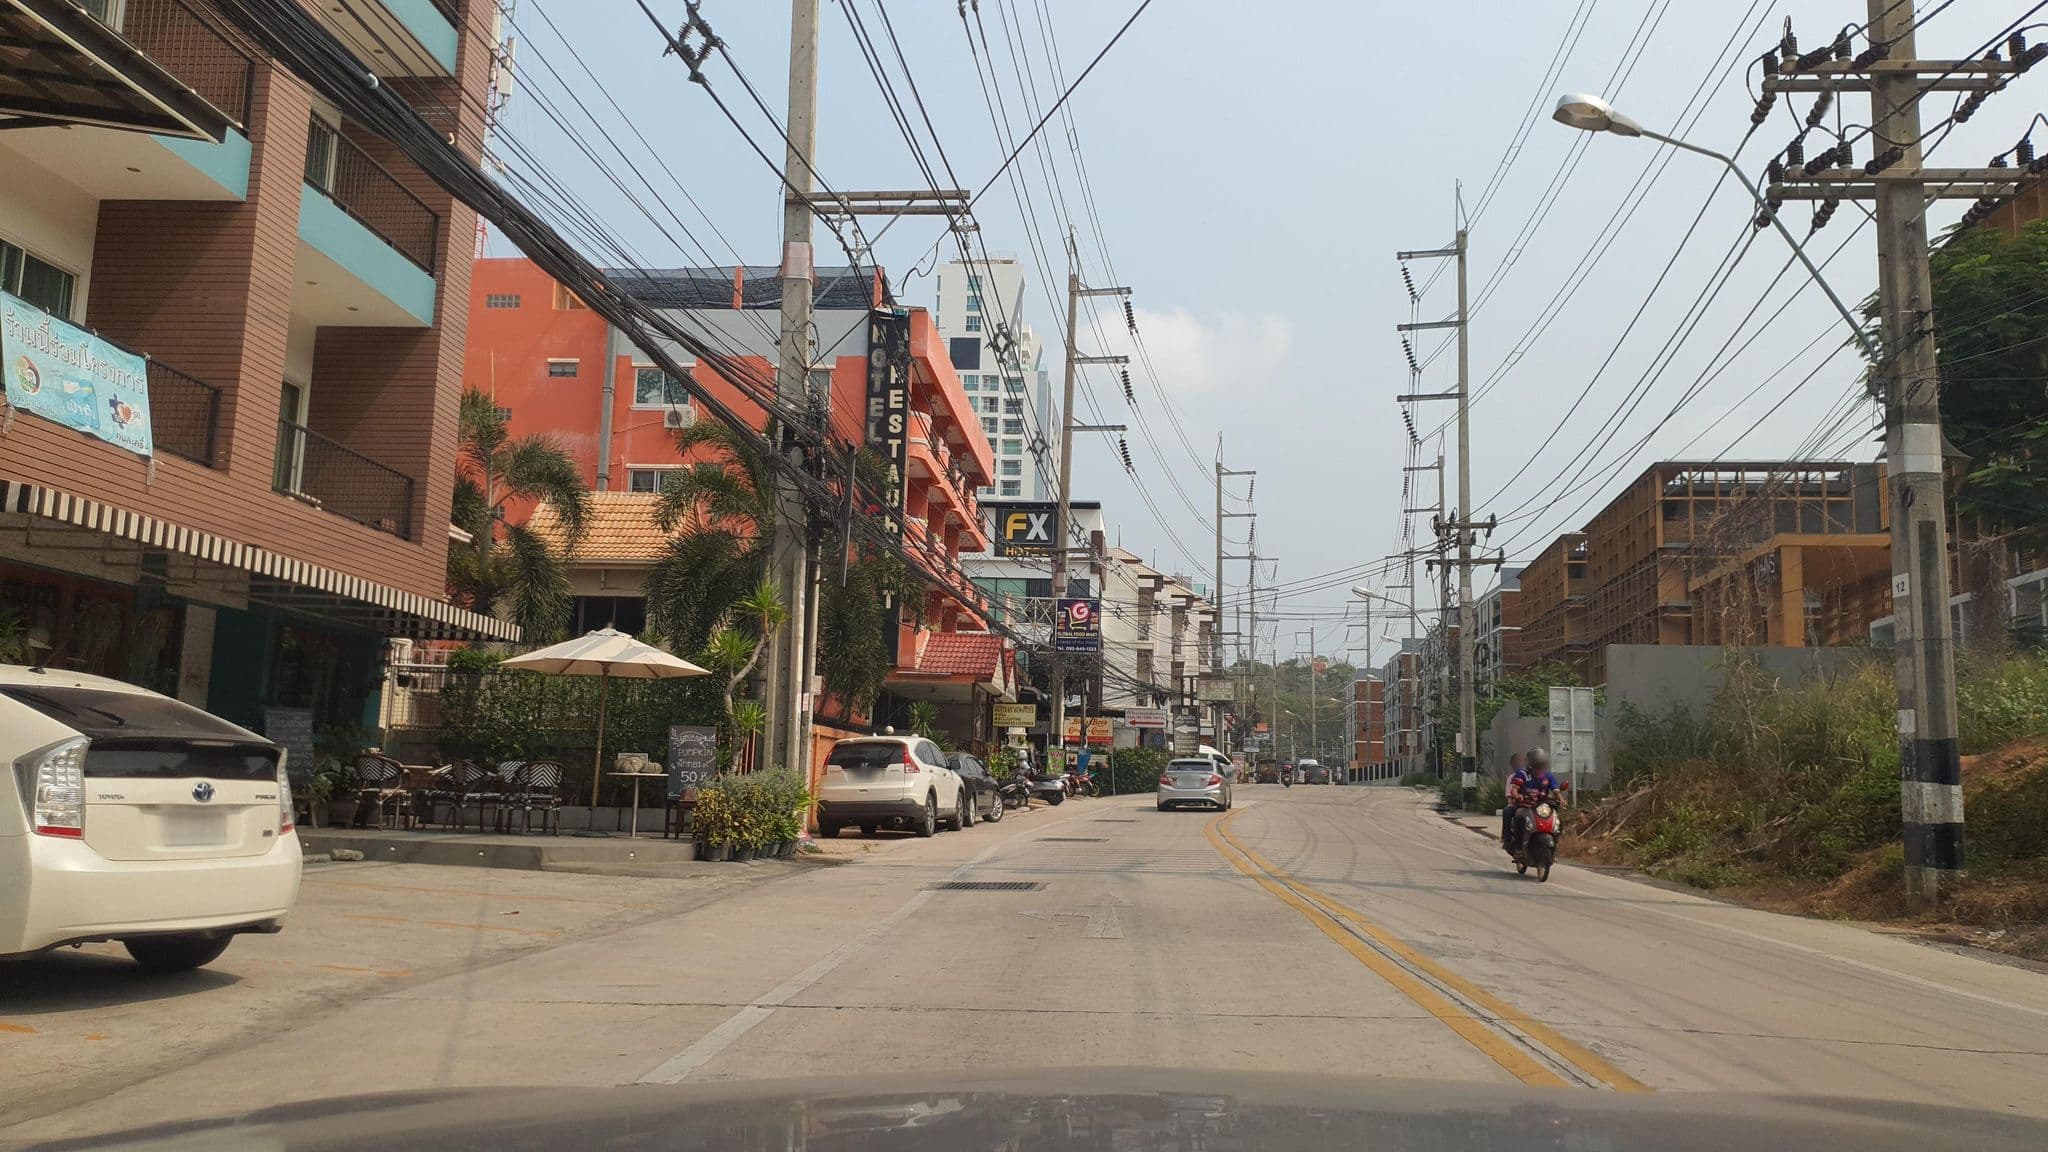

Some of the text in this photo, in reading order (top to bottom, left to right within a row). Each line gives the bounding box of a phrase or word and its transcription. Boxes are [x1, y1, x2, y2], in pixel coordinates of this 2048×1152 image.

[1006, 513, 1049, 540] FX
[1895, 581, 1905, 593] 12
[678, 748, 713, 756] PUMPKIN
[680, 770, 698, 782] 50
